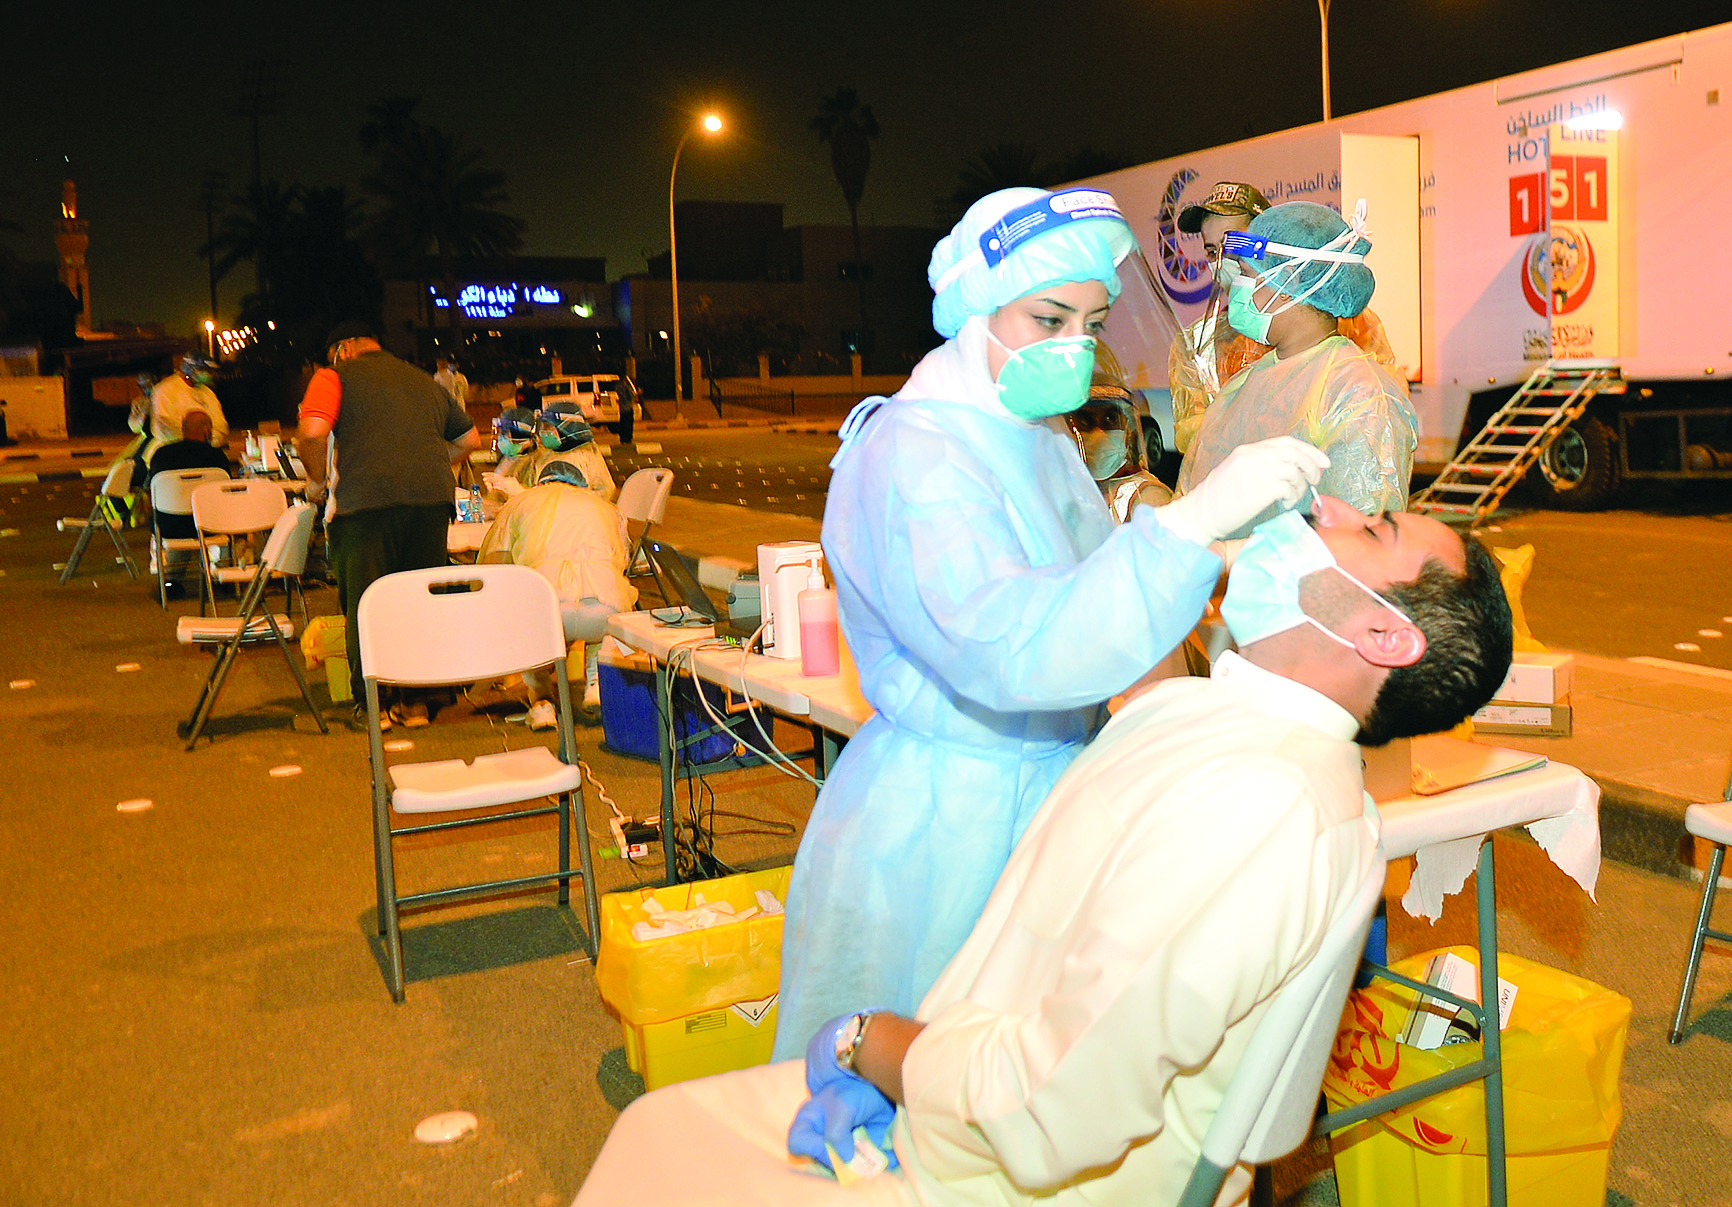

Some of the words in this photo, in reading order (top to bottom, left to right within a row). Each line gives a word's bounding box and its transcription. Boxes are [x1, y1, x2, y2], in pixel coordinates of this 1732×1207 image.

[1507, 103, 1563, 135] الساخن
[1570, 94, 1605, 119] الخط
[1508, 137, 1548, 164] HOT
[1561, 123, 1606, 142] LINE
[1062, 197, 1094, 207] Face
